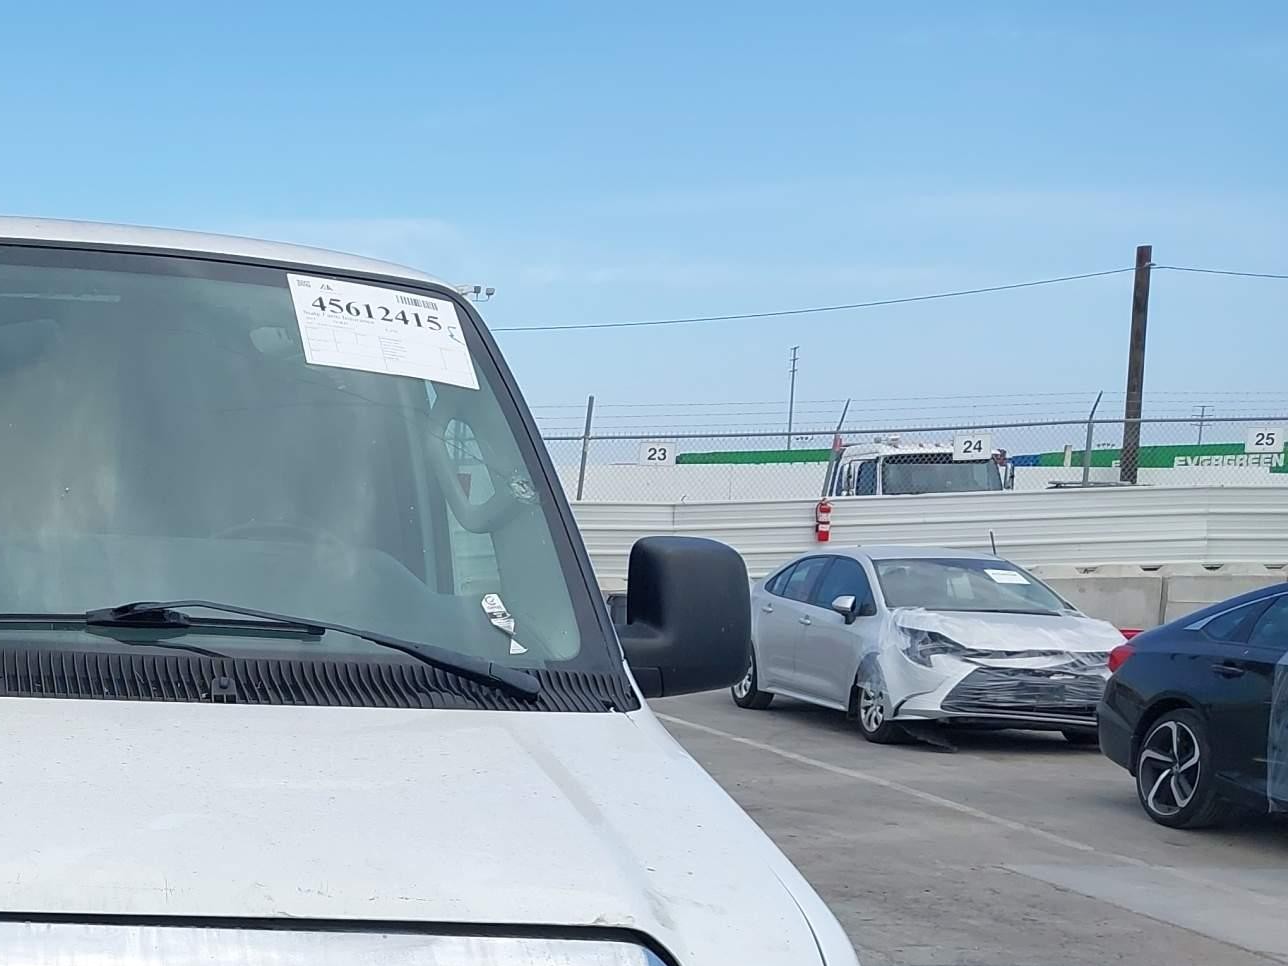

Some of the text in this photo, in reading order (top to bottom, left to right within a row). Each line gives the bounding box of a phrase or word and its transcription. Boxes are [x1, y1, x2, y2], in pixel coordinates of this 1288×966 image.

[311, 295, 442, 331] 45612415
[962, 439, 983, 454] 24
[1254, 432, 1276, 446] 25
[647, 447, 667, 461] 23
[1173, 453, 1285, 468] EVERGREEN
